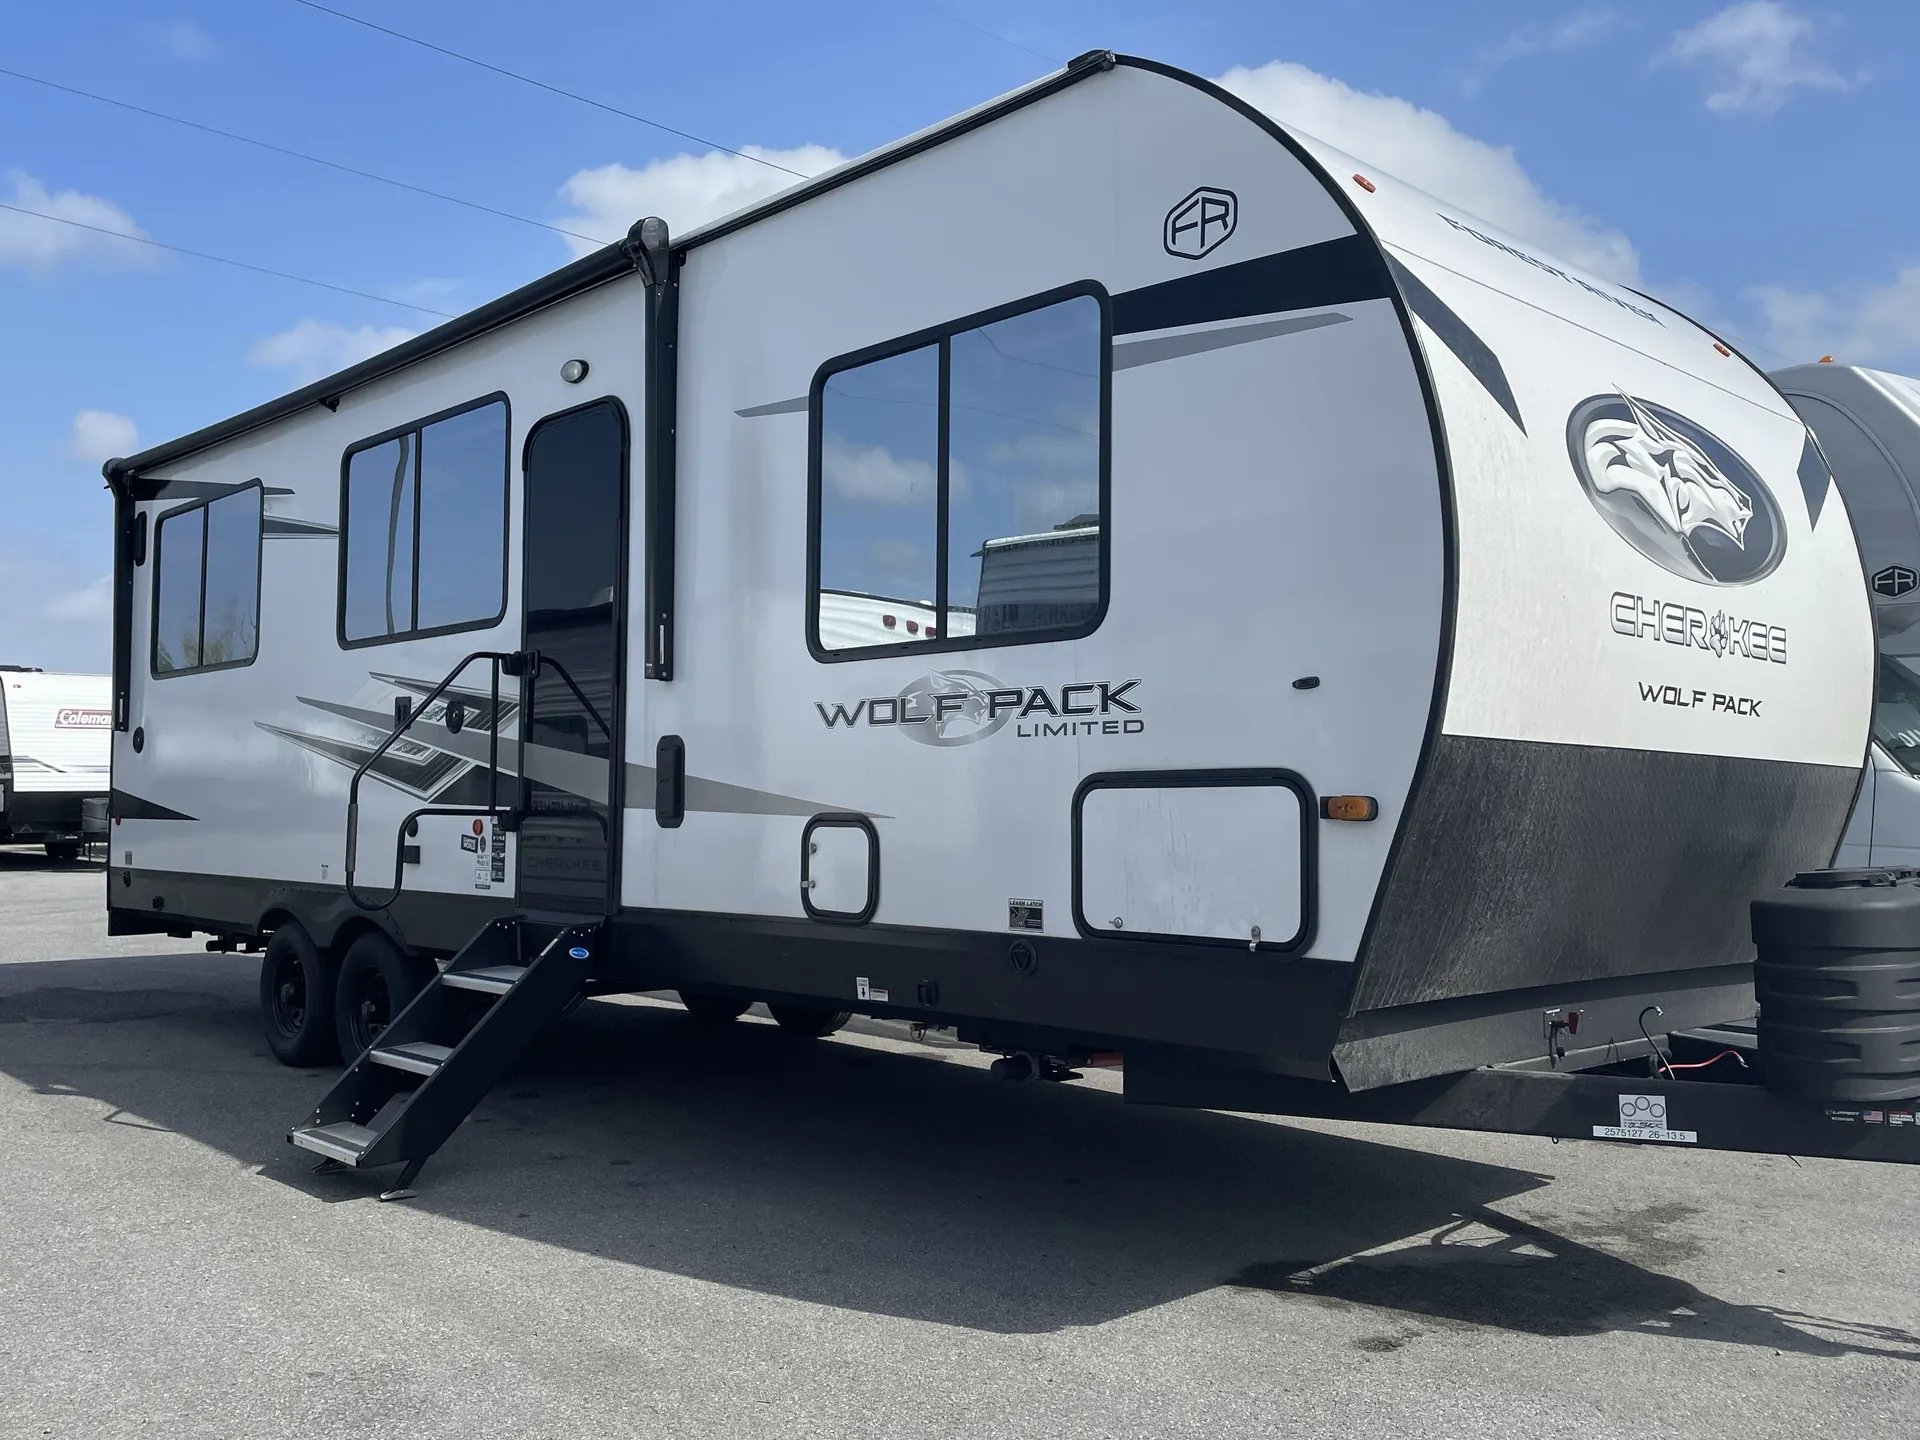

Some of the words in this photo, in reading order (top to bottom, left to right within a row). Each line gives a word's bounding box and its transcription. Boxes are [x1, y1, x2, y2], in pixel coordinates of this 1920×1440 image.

[1171, 196, 1230, 249] FR
[1436, 212, 1573, 284] FOREST
[1572, 277, 1668, 329] RIVER
[1874, 568, 1914, 594] FR
[813, 691, 970, 730] WOLF
[983, 678, 1142, 720] PACK
[1638, 681, 1707, 708] WOLF
[1712, 692, 1763, 718] PACK
[1016, 719, 1145, 738] LIMITED
[1604, 1127, 1643, 1138] 2575127
[1648, 1130, 1686, 1141] 26-13.5
